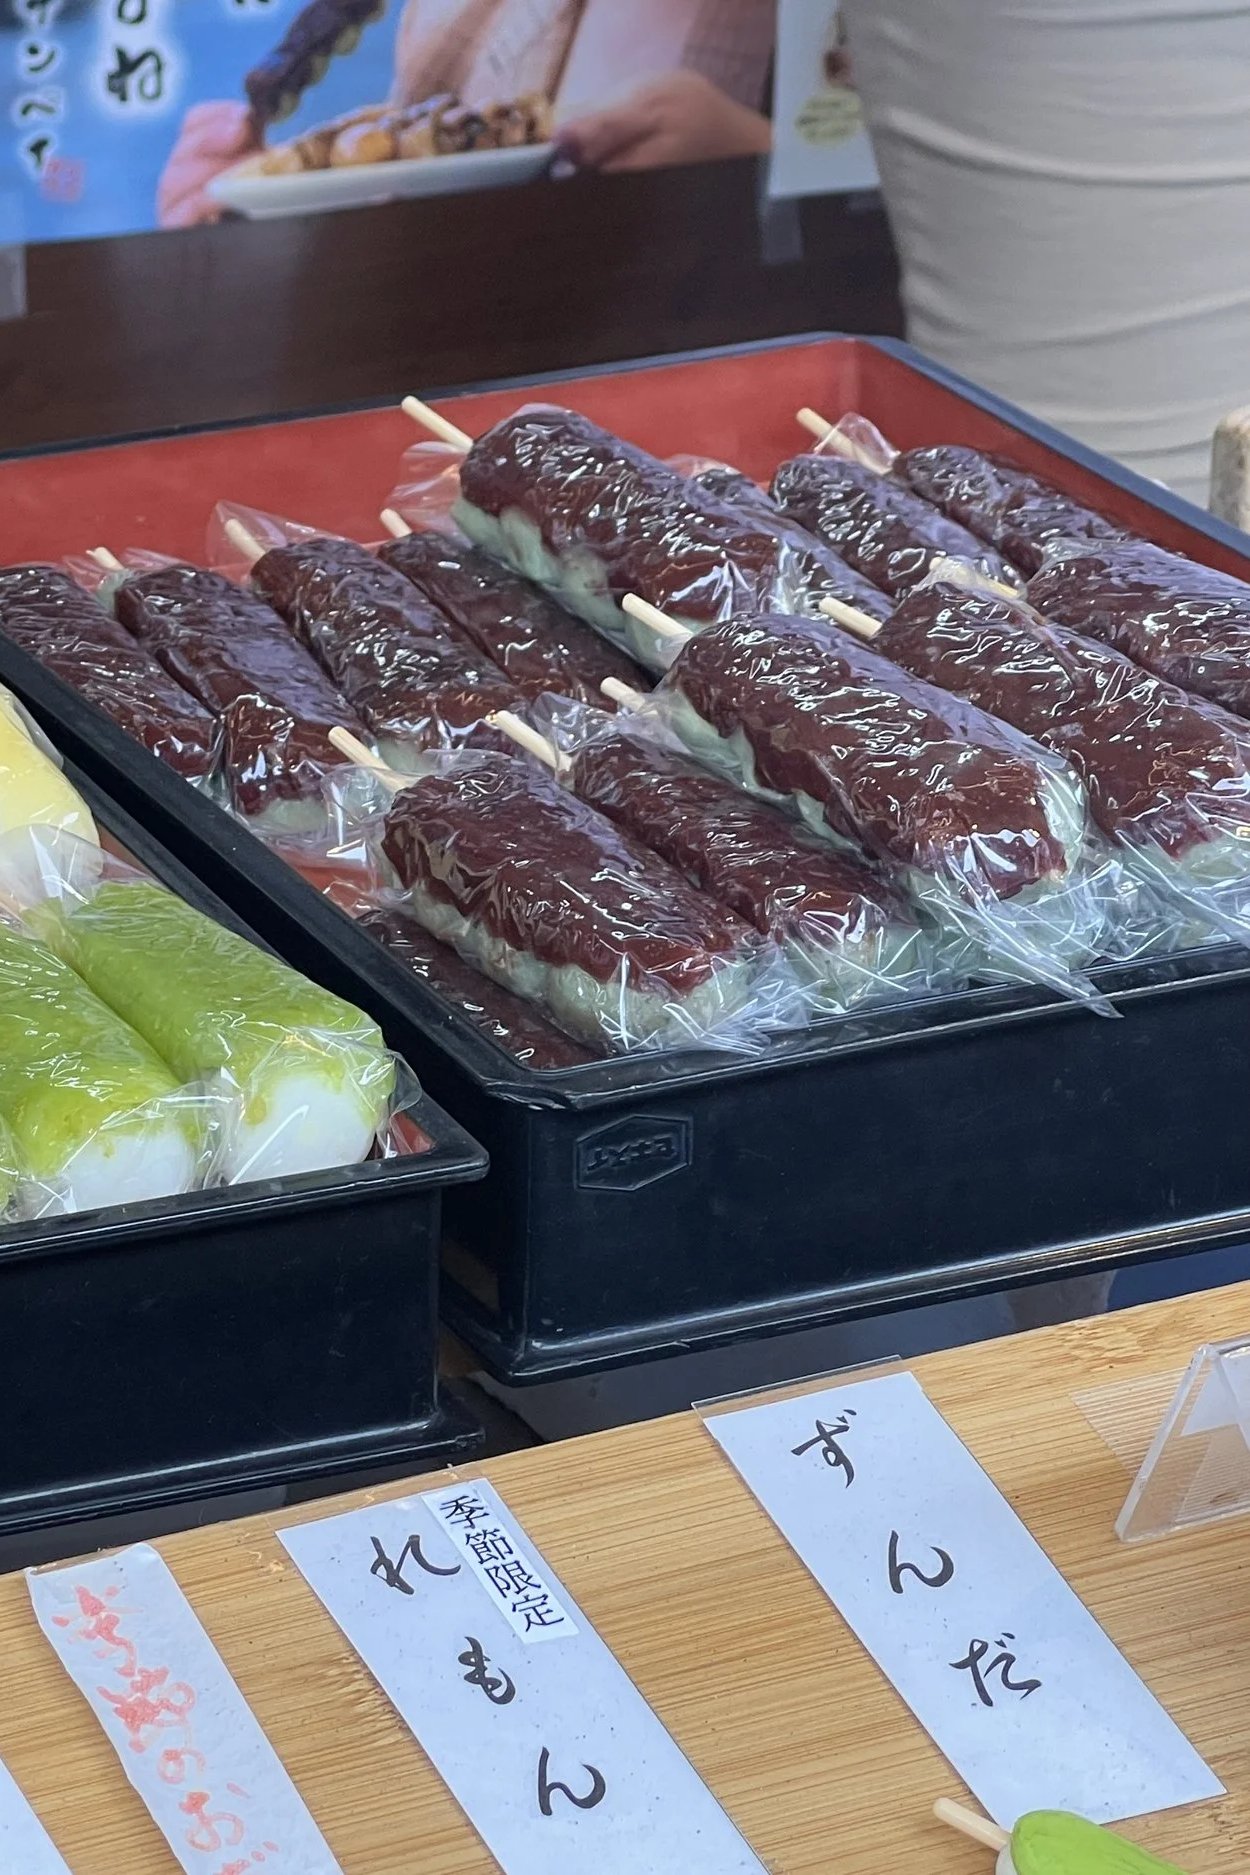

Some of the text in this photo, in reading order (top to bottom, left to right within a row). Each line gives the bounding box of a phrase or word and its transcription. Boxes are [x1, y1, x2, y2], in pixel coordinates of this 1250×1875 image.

[370, 1532, 606, 1817] れもん
[439, 1495, 565, 1633] 季節限定
[790, 1408, 1042, 1707] ずんだ
